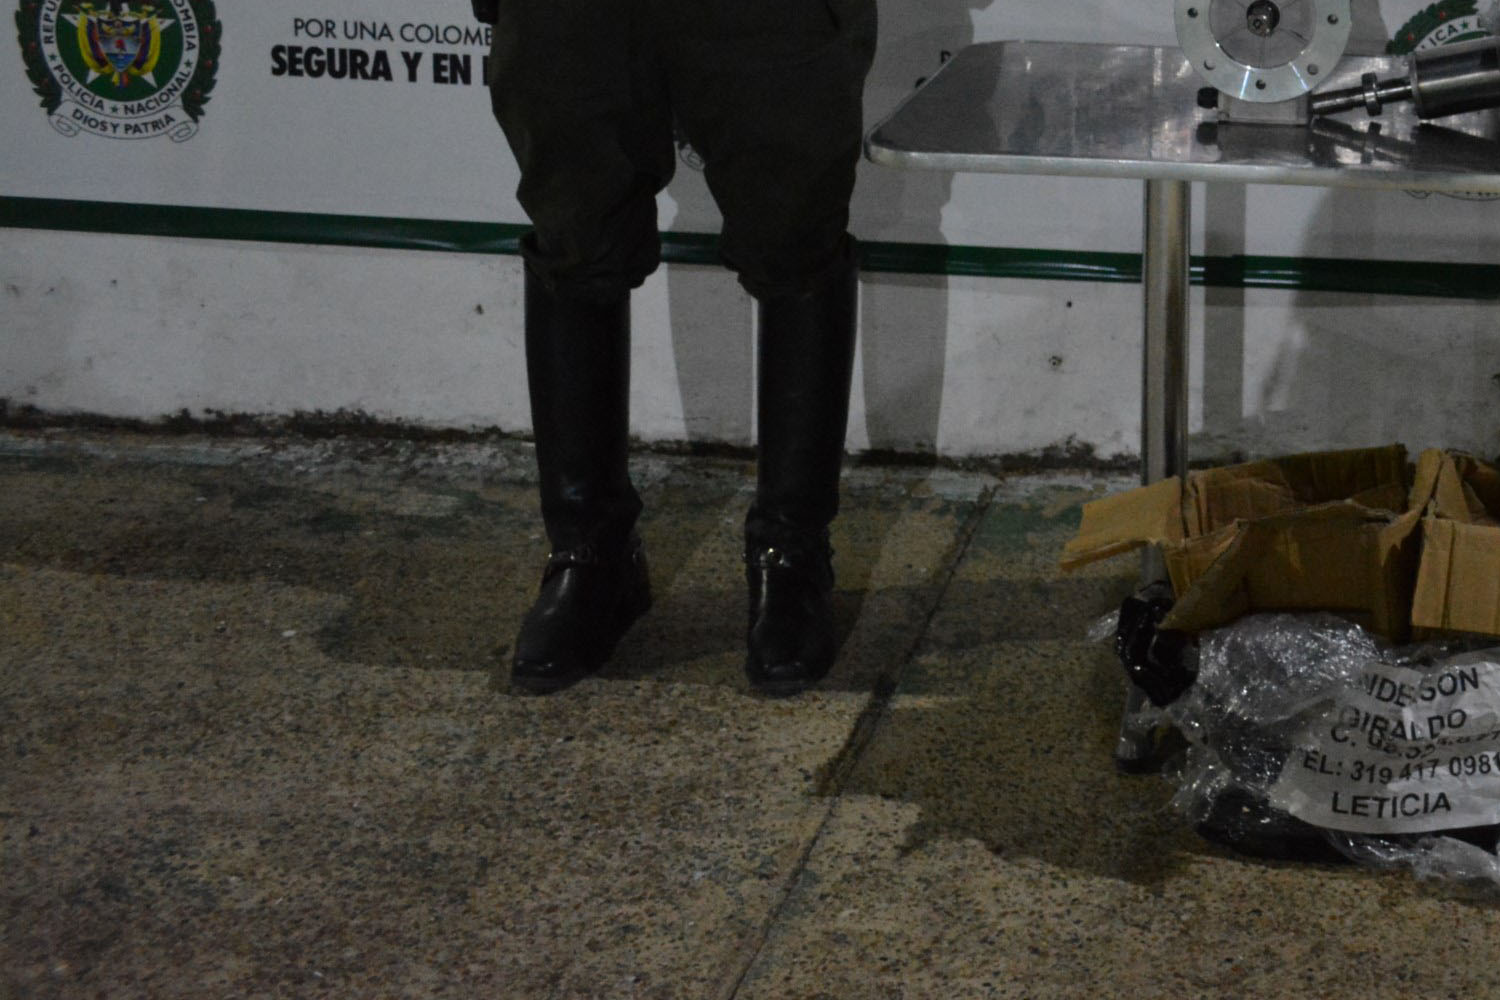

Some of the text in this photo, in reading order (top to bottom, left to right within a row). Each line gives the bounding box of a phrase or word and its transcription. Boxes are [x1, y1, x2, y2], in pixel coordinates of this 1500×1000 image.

[294, 18, 336, 38] POR
[344, 22, 394, 41] UNA
[269, 45, 393, 81] SEGURA
[401, 52, 422, 82] Y
[432, 53, 471, 84] EN
[124, 71, 191, 114] NACIONAL
[125, 114, 175, 134] PATRIA
[1350, 760, 1393, 785] 319
[1331, 791, 1452, 818] LETICIA
